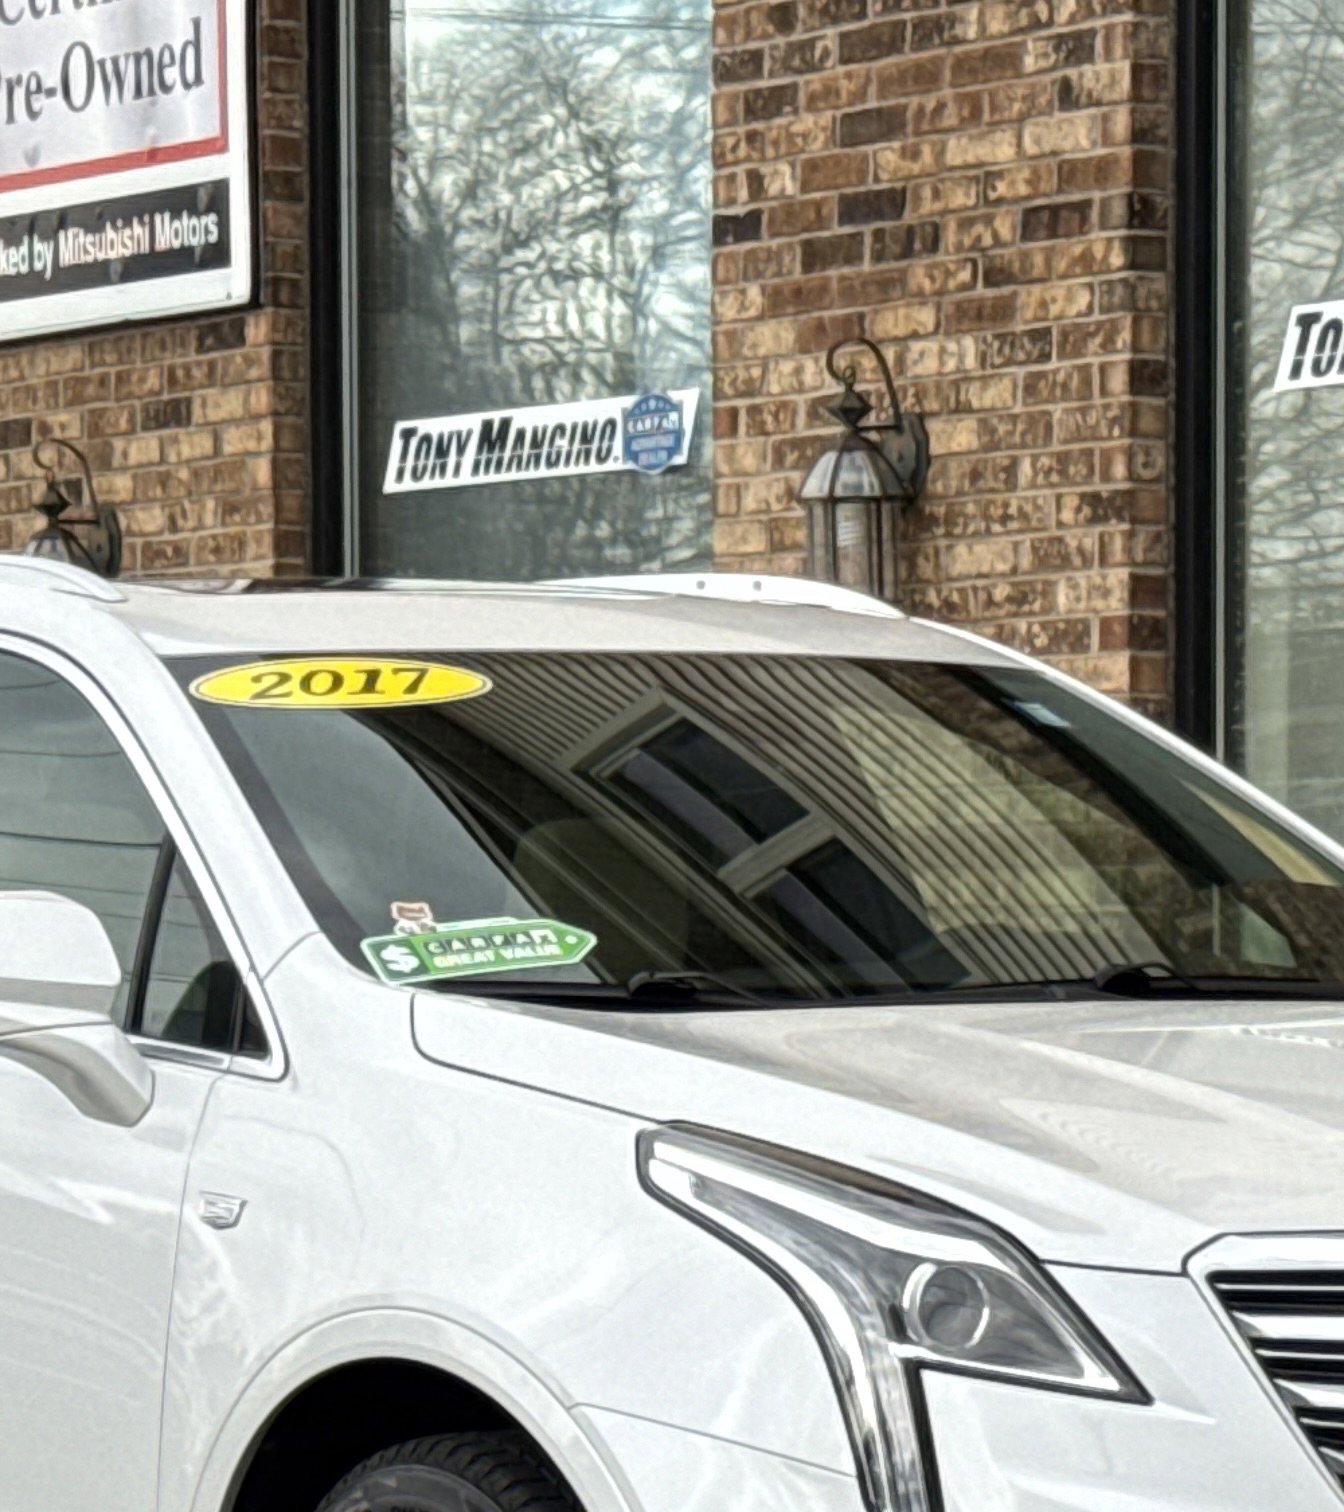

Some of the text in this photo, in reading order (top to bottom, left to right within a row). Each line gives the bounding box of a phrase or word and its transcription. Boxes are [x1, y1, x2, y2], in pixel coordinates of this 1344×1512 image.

[33, 232, 54, 281] by
[58, 213, 150, 268] Mitsubishi
[154, 210, 218, 251] Motors
[250, 668, 430, 701] 2017
